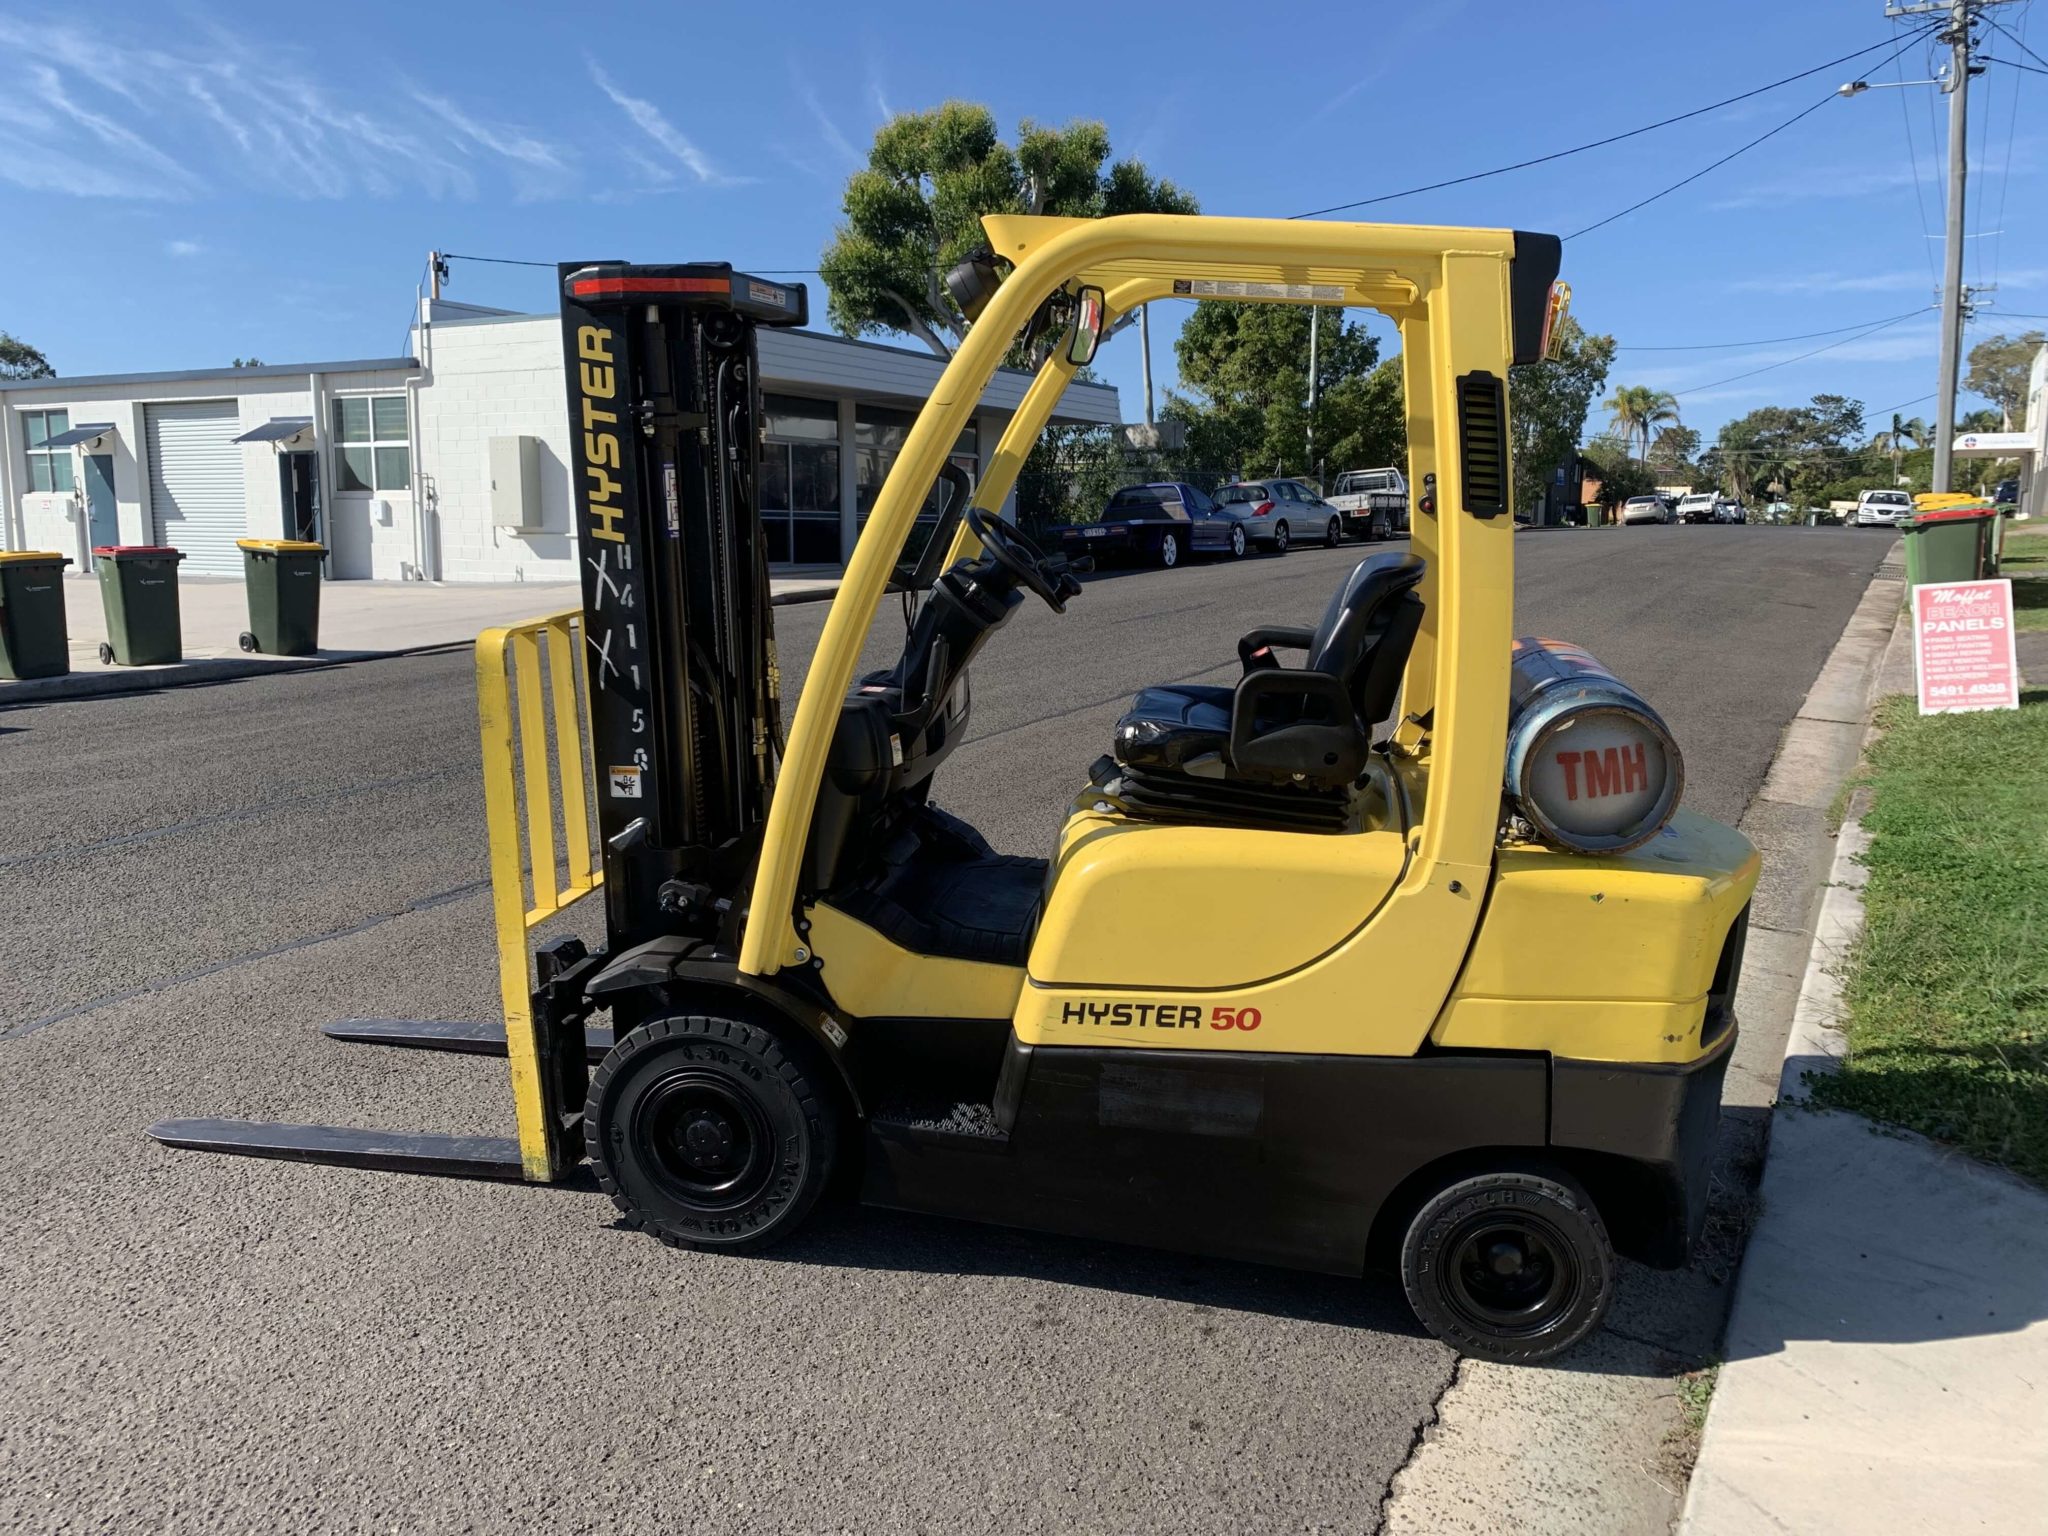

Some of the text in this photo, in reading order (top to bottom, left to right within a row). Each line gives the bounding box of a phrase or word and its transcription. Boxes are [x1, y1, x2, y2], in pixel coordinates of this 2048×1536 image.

[577, 325, 626, 543] HYSTER
[1931, 588, 1993, 604] Moffat
[1927, 602, 2000, 620] BEACH
[1922, 617, 2005, 634] PANELS
[1556, 742, 1648, 801] TMH
[1061, 1001, 1262, 1032] HYSTER 50
